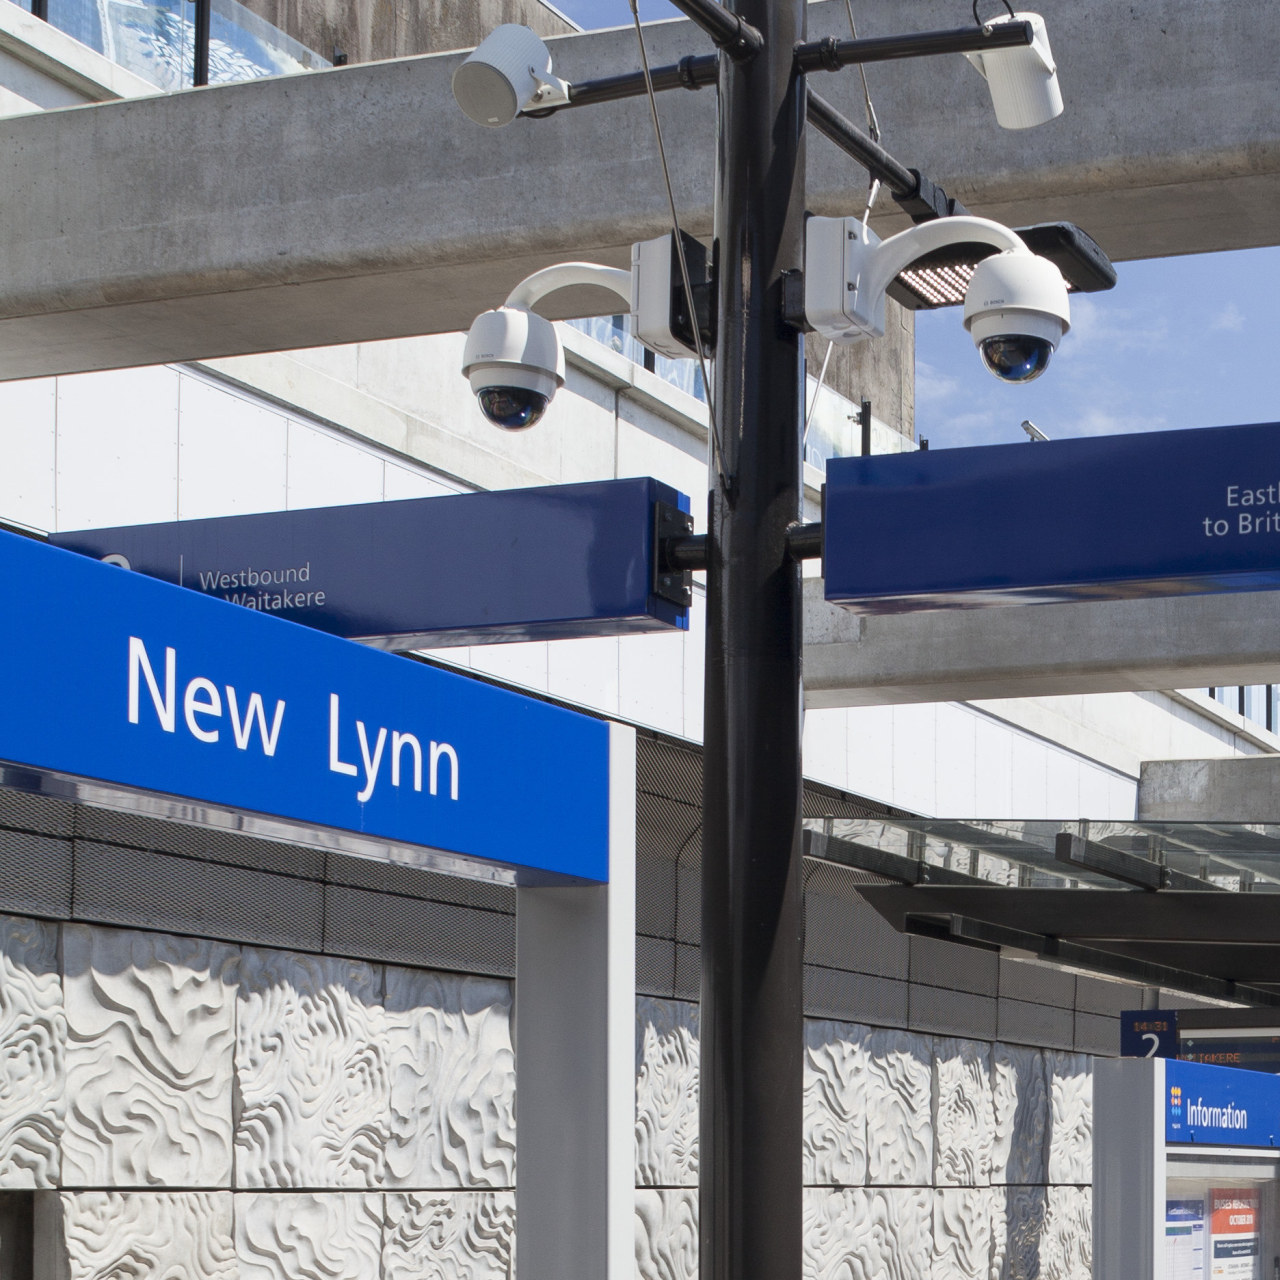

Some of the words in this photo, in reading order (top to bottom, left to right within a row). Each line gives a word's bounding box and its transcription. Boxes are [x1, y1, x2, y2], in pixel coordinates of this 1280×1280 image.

[1202, 515, 1229, 537] to
[199, 561, 311, 591] Westbound
[128, 636, 286, 757] New
[329, 692, 459, 803] Lynn
[1133, 1021, 1168, 1032] 14:31
[1187, 1097, 1247, 1130] Information
